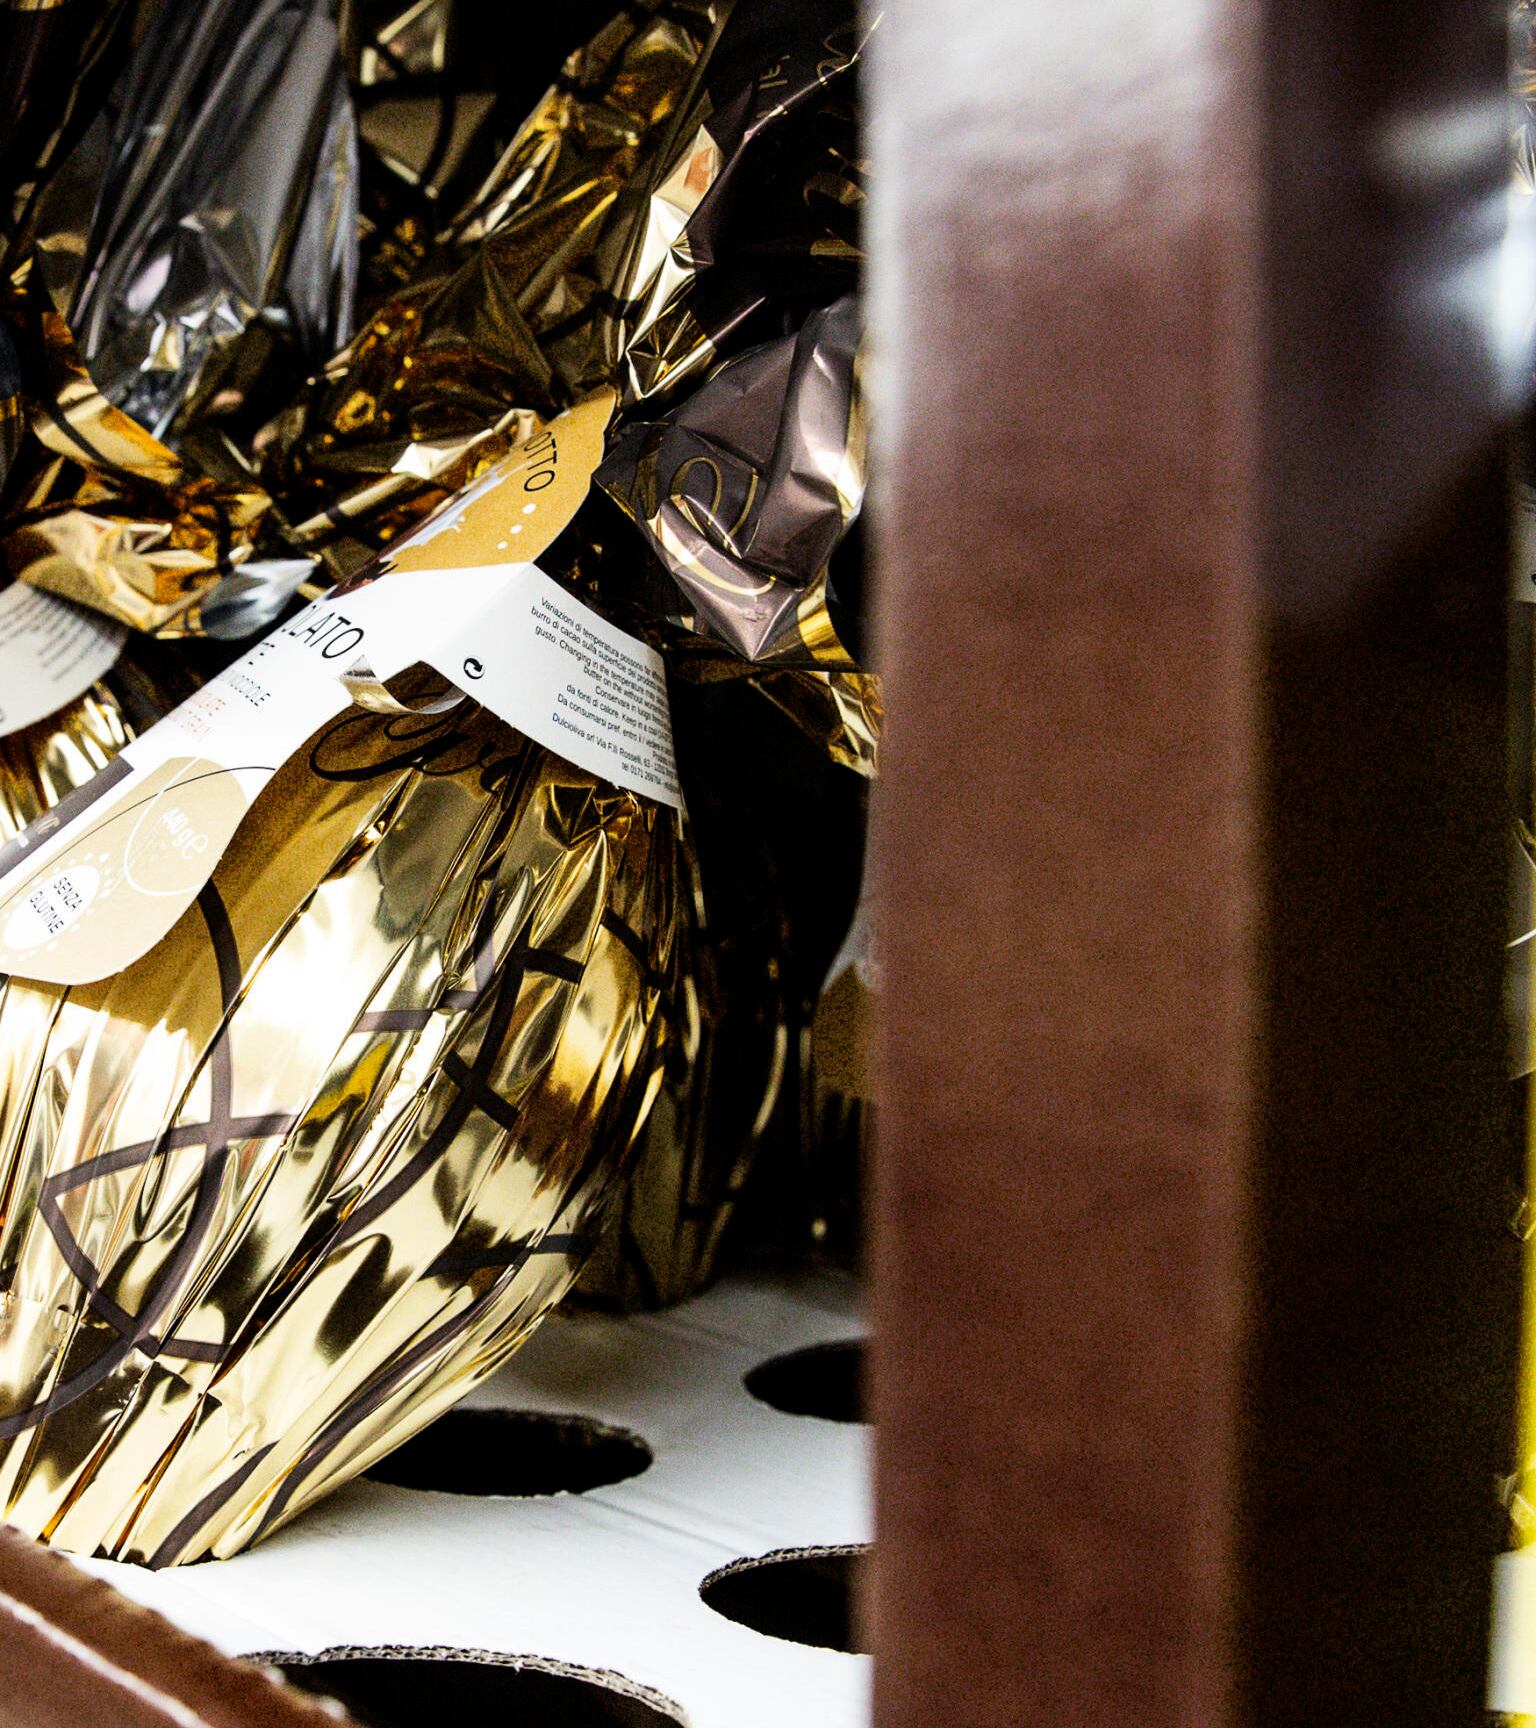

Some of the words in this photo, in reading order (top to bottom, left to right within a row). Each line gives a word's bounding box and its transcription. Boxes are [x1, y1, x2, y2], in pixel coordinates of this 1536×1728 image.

[531, 605, 551, 625] burro
[552, 620, 560, 630] di
[560, 626, 581, 644] cacao
[582, 639, 597, 655] sulla
[535, 625, 558, 645] gusto.
[559, 639, 592, 667] Changing
[541, 596, 575, 627] Variazioni
[583, 627, 619, 658] temperatura
[566, 684, 576, 695] da
[552, 712, 586, 739] Dulcioliva
[557, 693, 568, 706] Da
[568, 700, 606, 728] consumarsi
[29, 890, 65, 934] GLUTINE
[53, 876, 83, 912] SENZA
